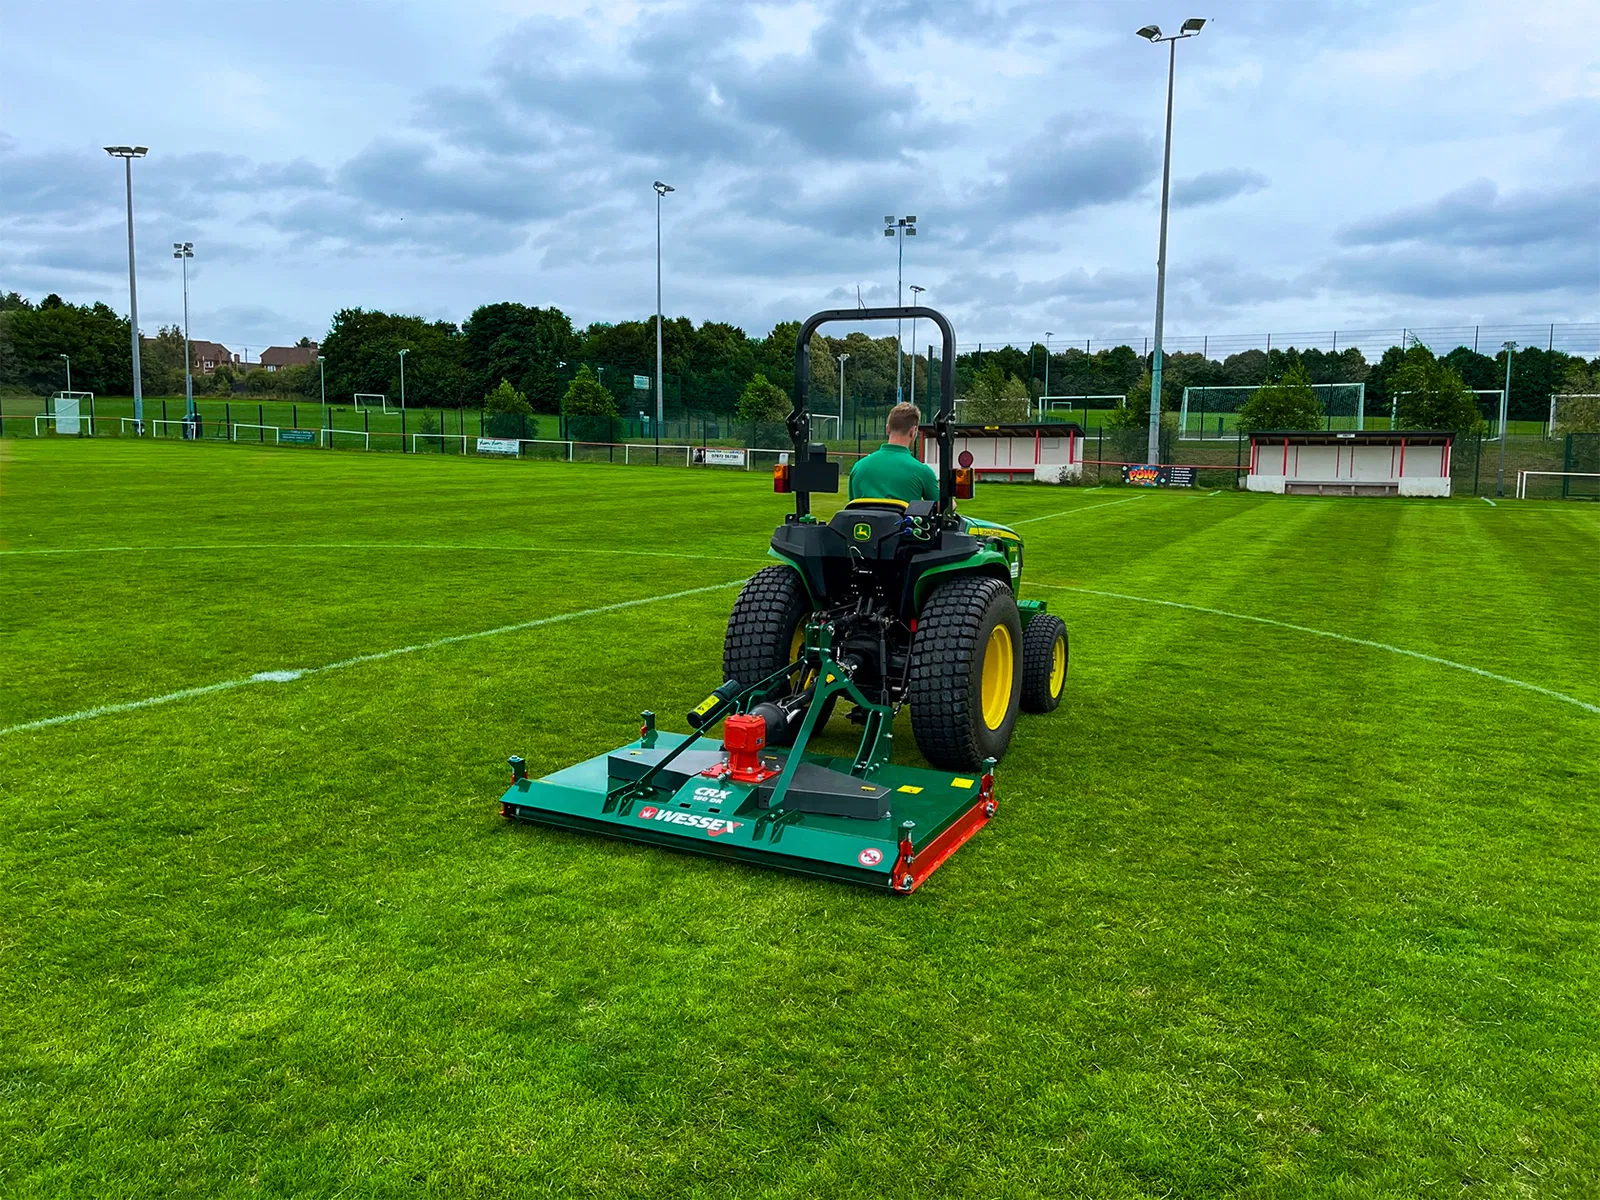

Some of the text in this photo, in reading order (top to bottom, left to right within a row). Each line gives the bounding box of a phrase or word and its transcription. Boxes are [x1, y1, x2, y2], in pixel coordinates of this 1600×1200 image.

[1128, 469, 1160, 481] POW!
[694, 787, 734, 800] CRX
[654, 809, 741, 836] WESSEX
